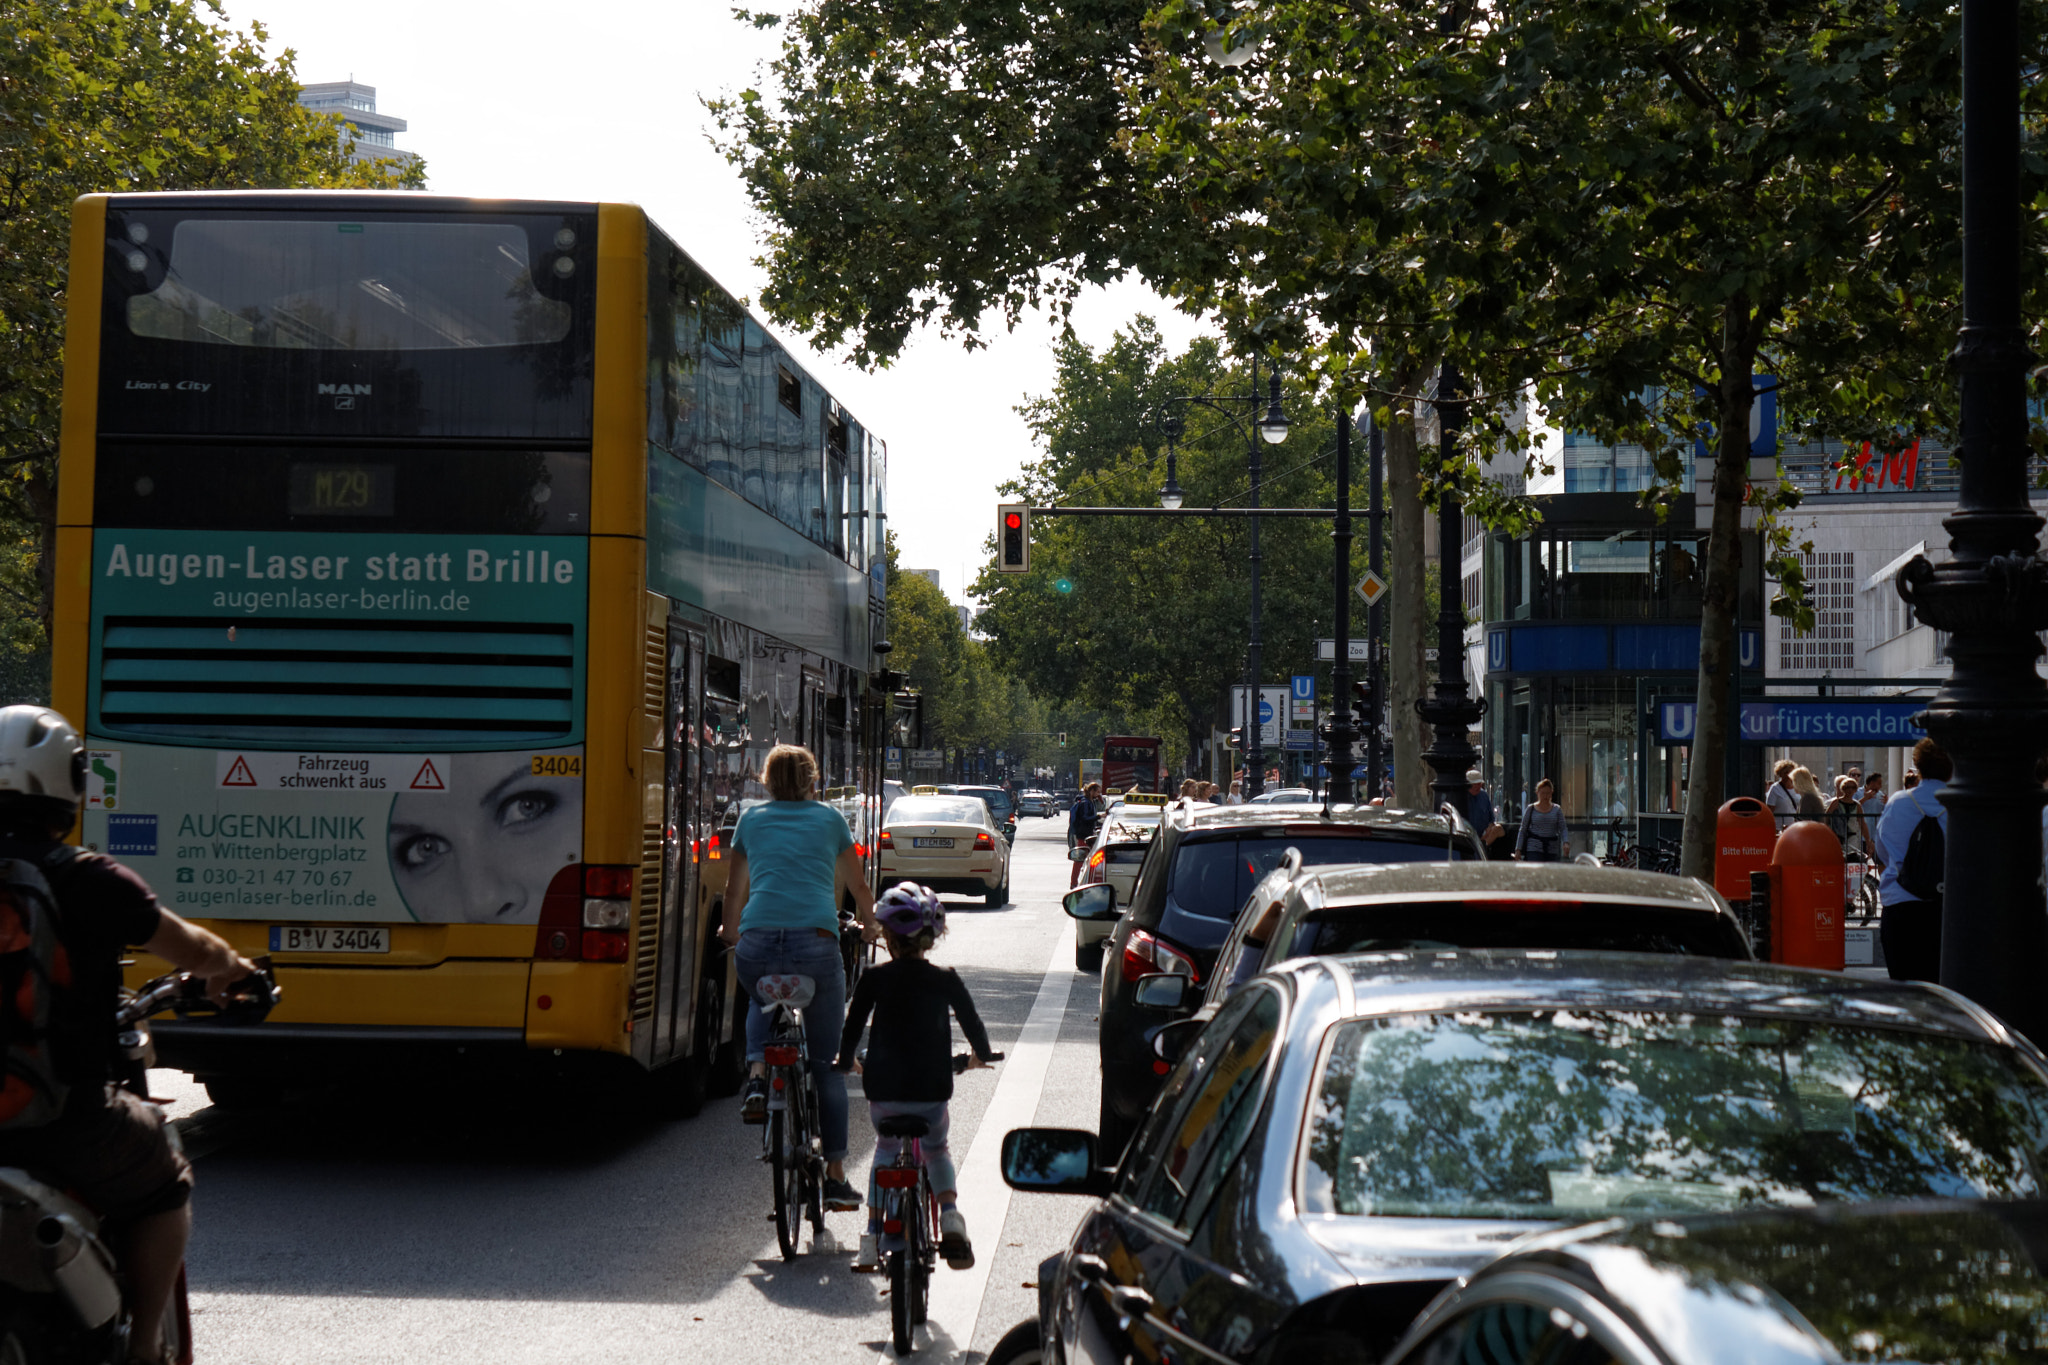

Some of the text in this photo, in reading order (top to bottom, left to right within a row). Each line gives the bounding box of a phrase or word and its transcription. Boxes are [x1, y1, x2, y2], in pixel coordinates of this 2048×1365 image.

[124, 380, 212, 393] Lion's City
[317, 383, 372, 396] MAN
[315, 470, 369, 508] M29
[105, 543, 575, 586] Augen-Laser statt Brille
[212, 586, 471, 613] augenlaser-berlin.de
[1350, 646, 1364, 655] Zoo
[1491, 632, 1503, 667] U
[1740, 631, 1754, 667] U
[1296, 678, 1311, 698] U
[1665, 705, 1927, 738] U Kurfürstendam
[298, 755, 370, 775] Fahrzeug
[532, 756, 582, 775] 3404
[279, 772, 387, 789] schwenkt aus
[1131, 795, 1161, 804] TAXI
[109, 817, 157, 825] LASERMED
[177, 813, 365, 840] AUGENKLINIK
[176, 842, 367, 865] am Wittenbergplatz
[1722, 846, 1768, 856] Bitte füttern
[203, 868, 353, 887] 030-21 47 70 67
[176, 887, 377, 907] augenlaser-berlin.de
[288, 929, 382, 950] B V 3404
